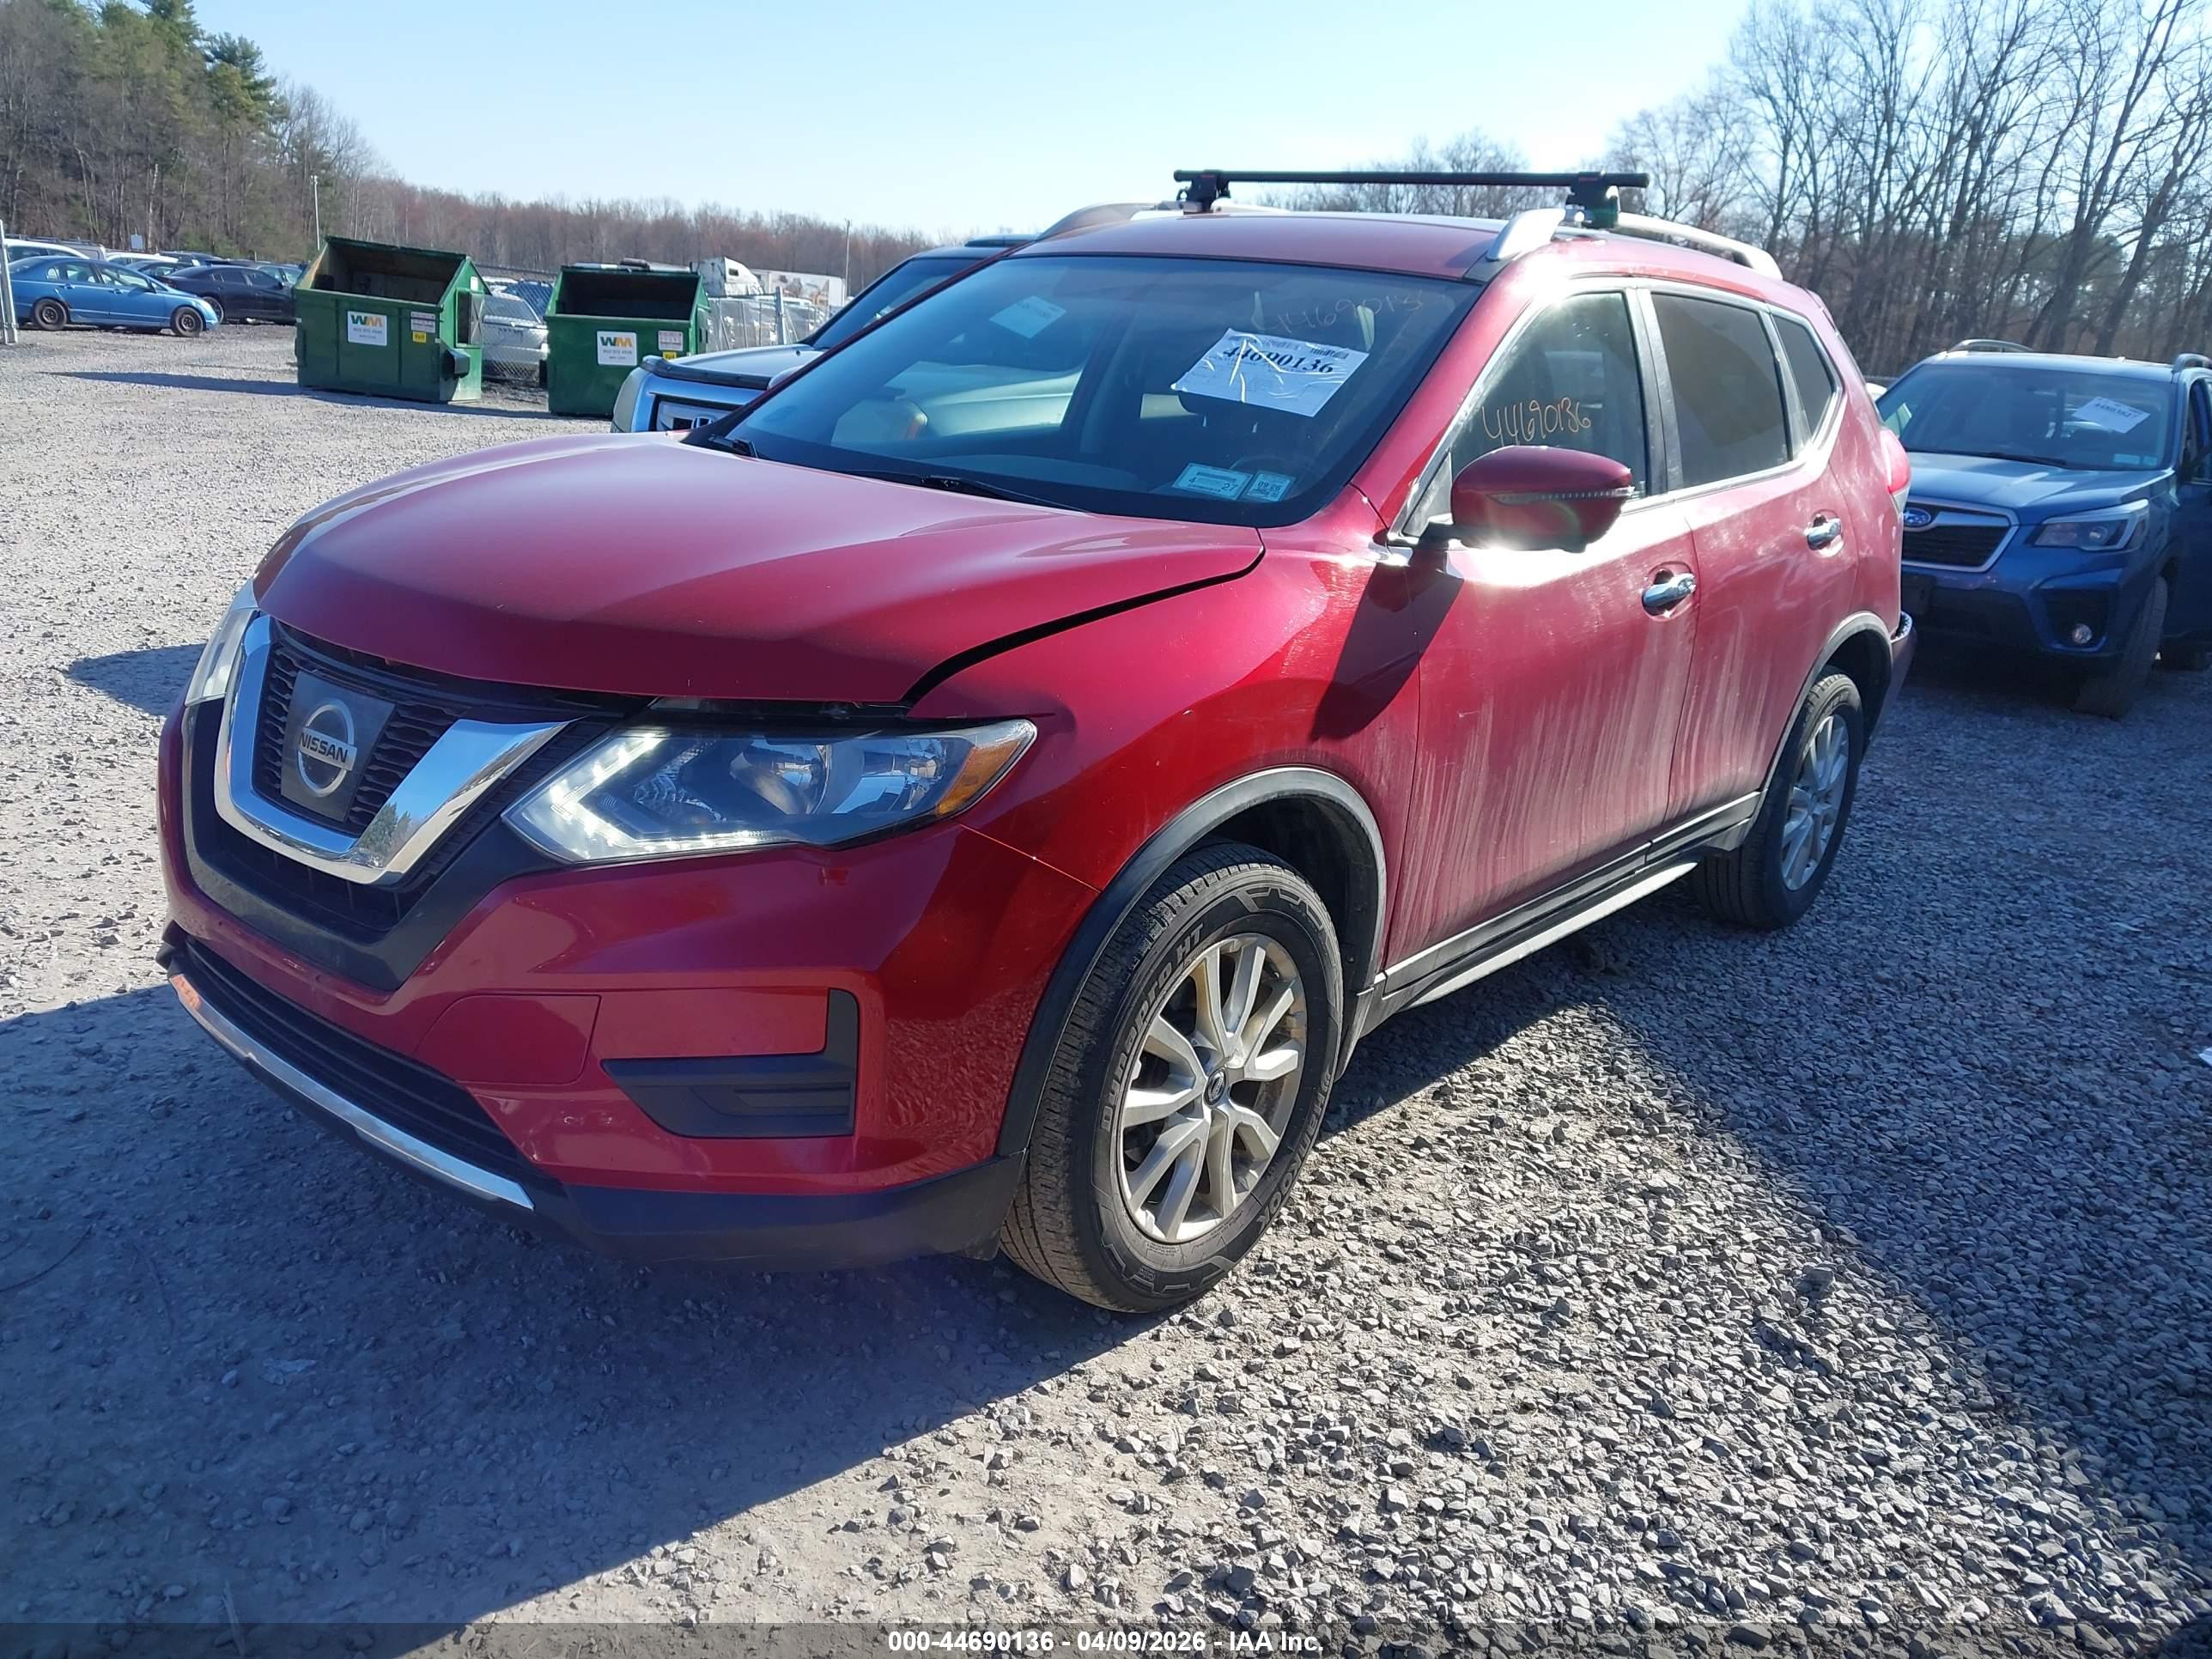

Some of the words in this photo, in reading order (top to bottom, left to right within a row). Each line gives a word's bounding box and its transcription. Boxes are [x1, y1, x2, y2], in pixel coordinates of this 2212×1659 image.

[349, 314, 382, 326] WM
[600, 337, 633, 348] WM
[1481, 397, 1591, 447] 44690136
[298, 732, 349, 763] NISSAN
[1101, 961, 1173, 1131] Dynapro
[1176, 922, 1204, 963] HT
